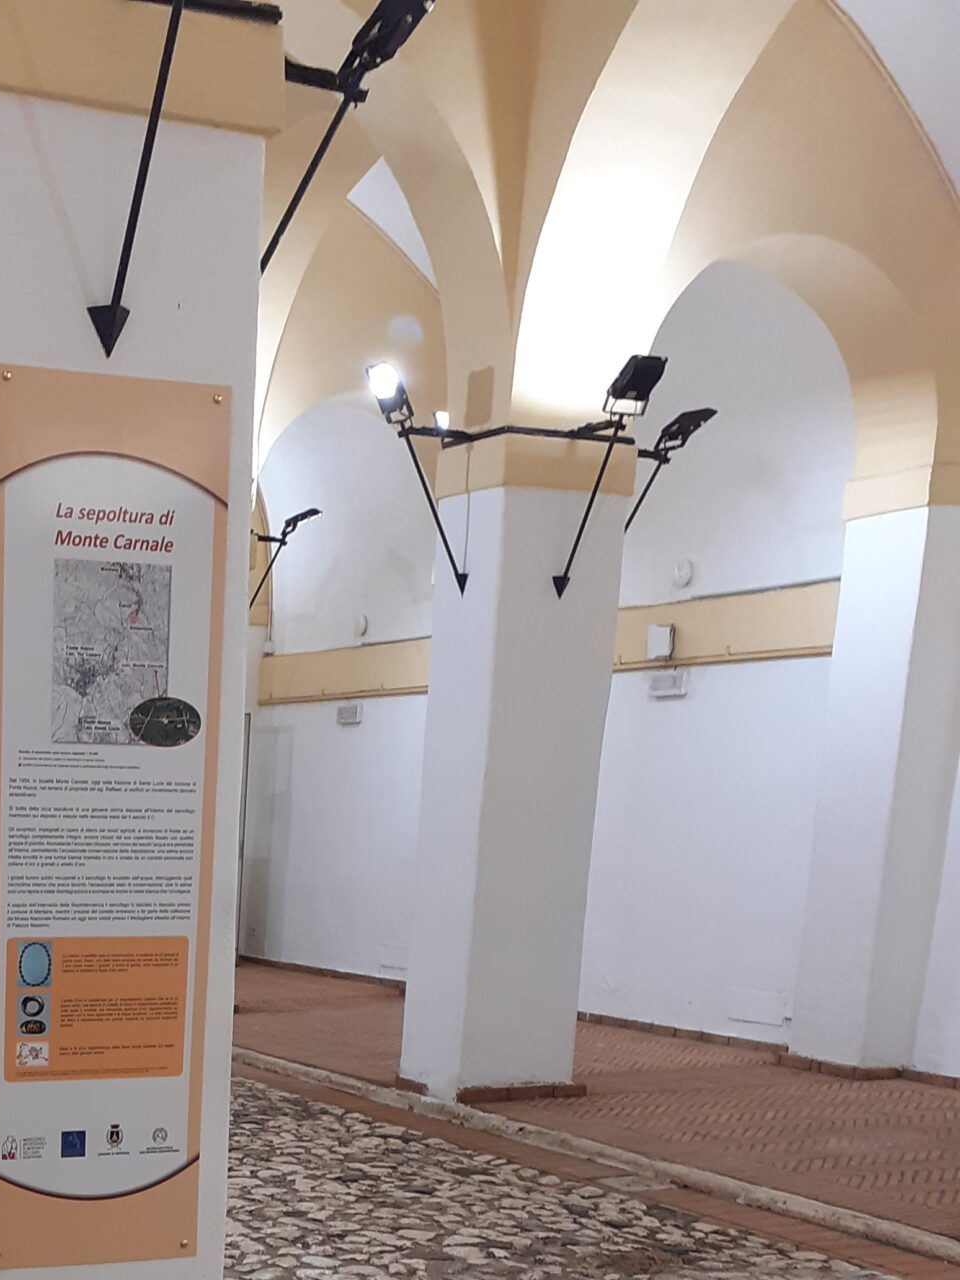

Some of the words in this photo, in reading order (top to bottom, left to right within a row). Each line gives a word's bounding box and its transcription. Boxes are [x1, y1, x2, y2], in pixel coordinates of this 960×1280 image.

[55, 502, 74, 519] La
[77, 506, 155, 525] sepoltura
[158, 509, 176, 526] di
[54, 530, 109, 549] Monte
[113, 534, 174, 553] Carnale
